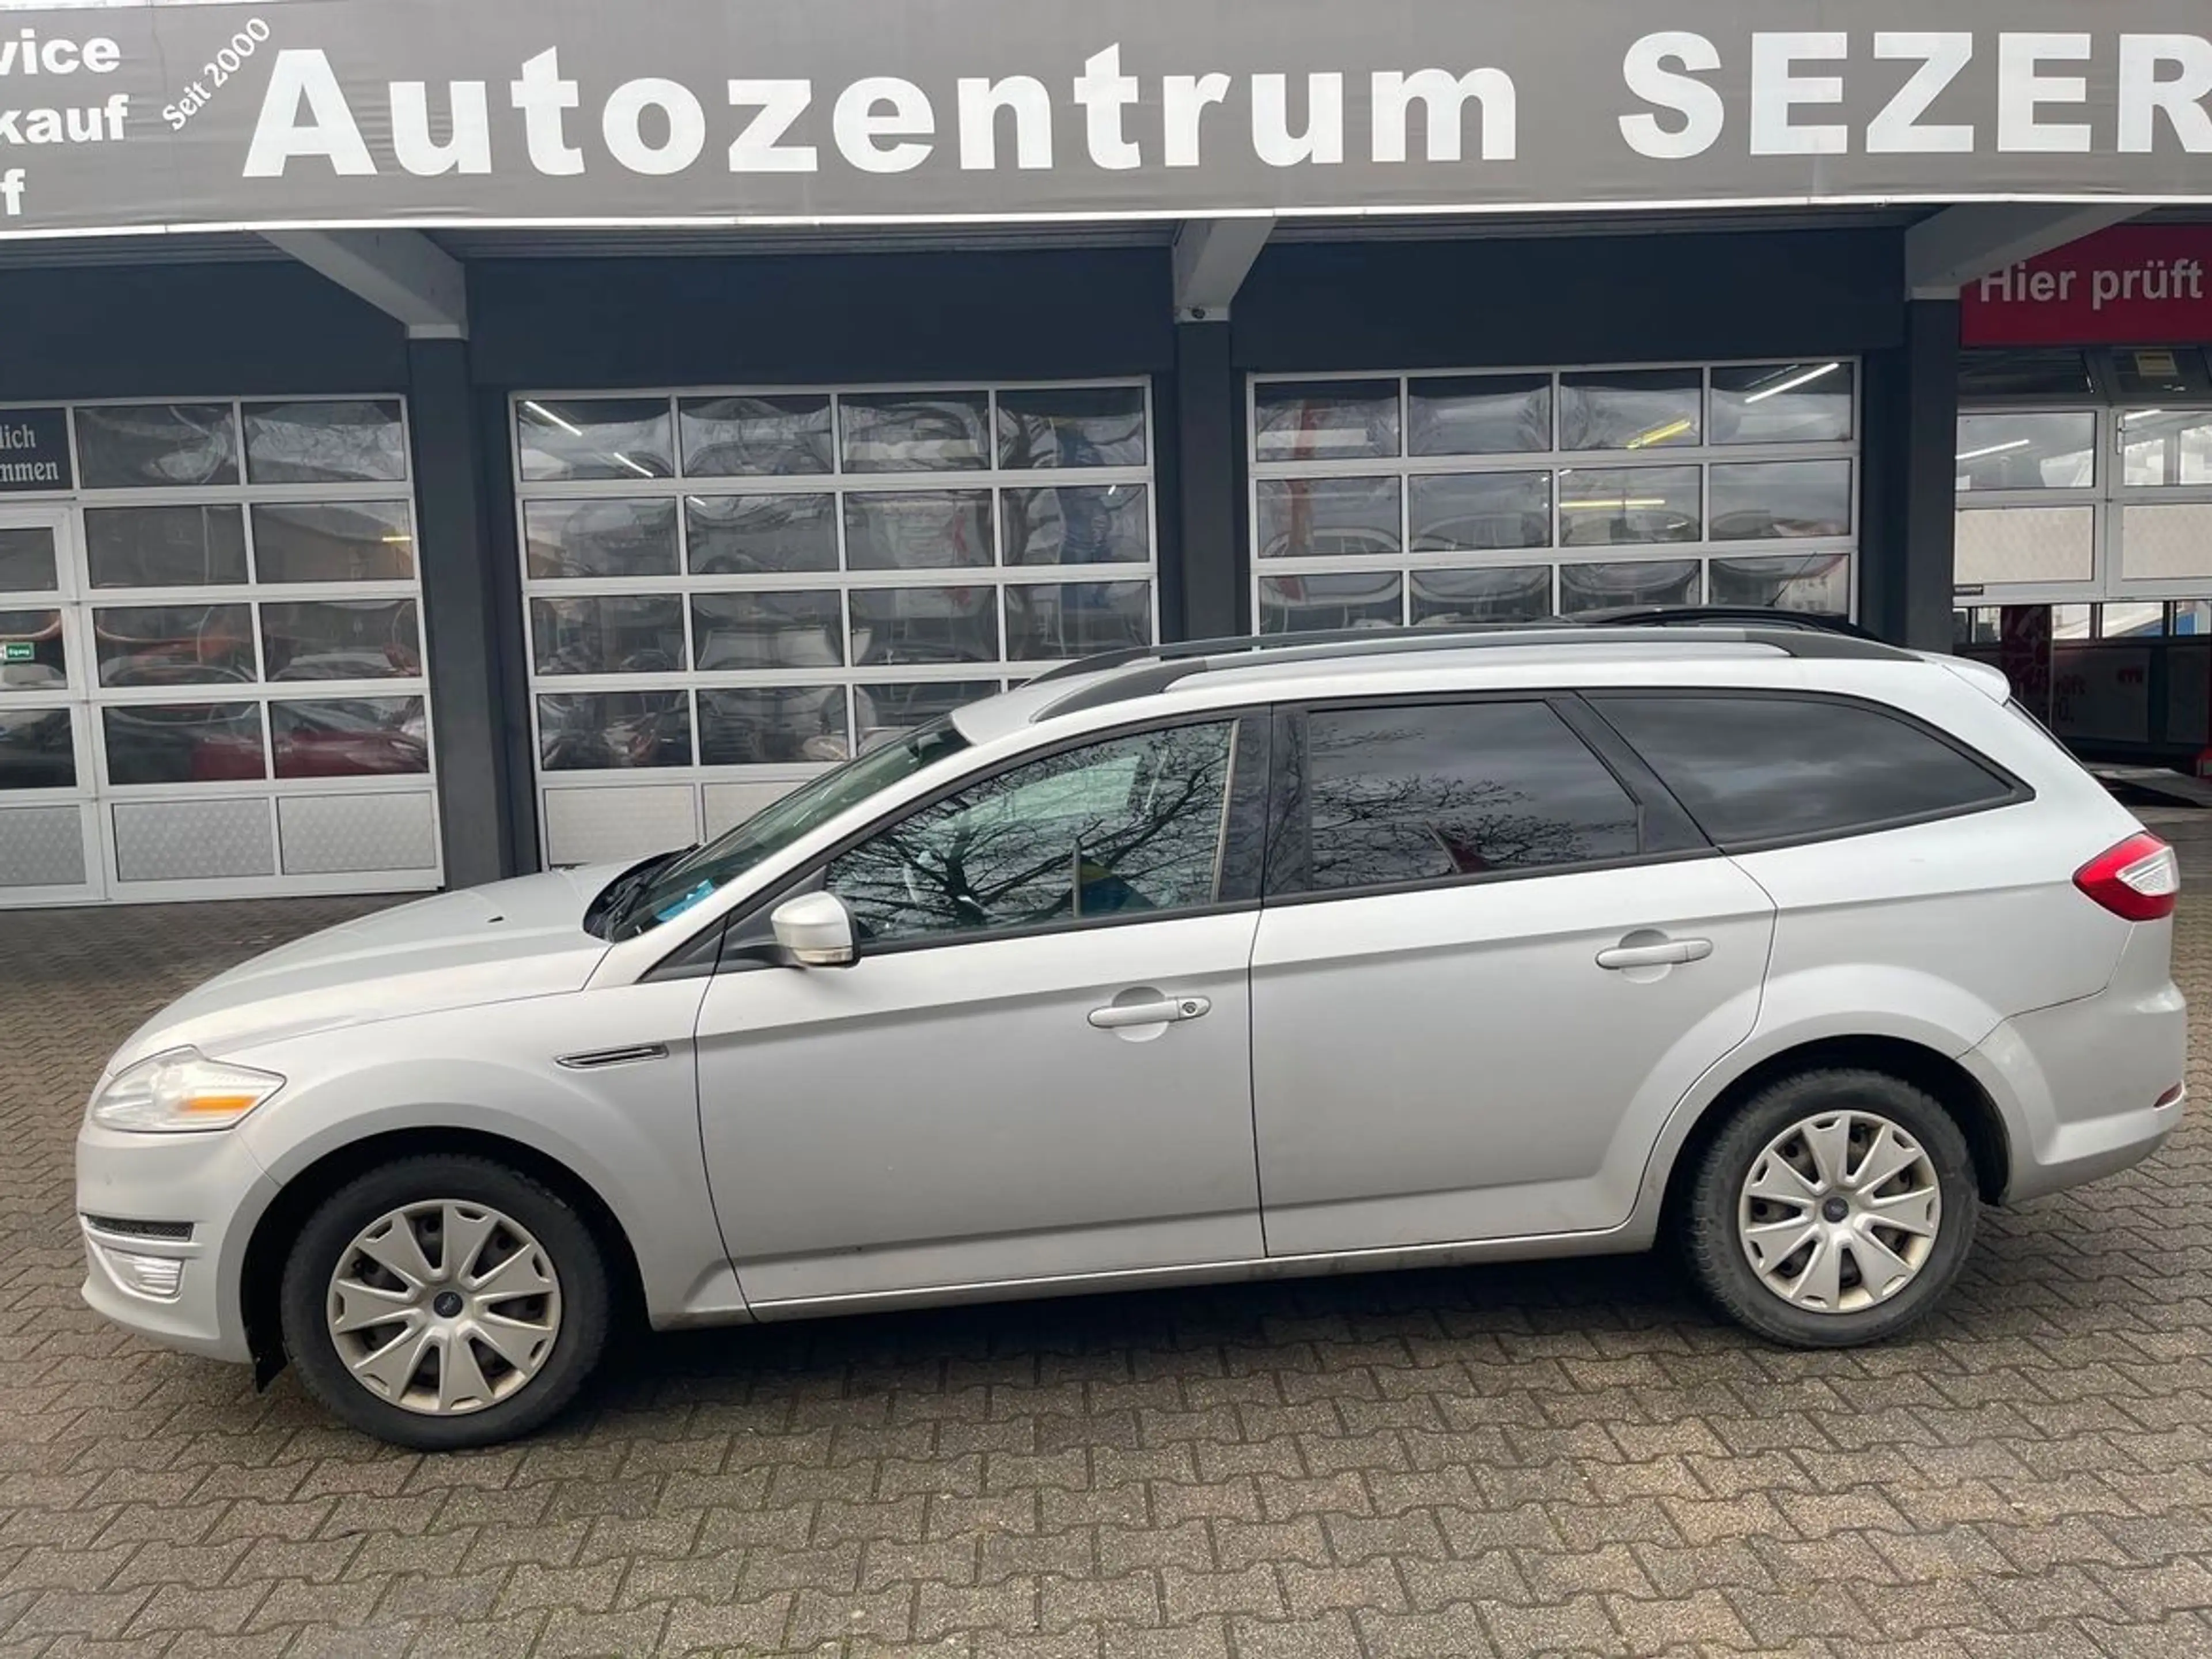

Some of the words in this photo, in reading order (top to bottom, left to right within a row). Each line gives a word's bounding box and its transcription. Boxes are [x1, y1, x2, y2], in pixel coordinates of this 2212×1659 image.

[162, 81, 212, 131] Seit
[204, 18, 270, 88] 2000
[242, 43, 1516, 177] Autozentrum
[1618, 31, 2212, 159] SEZER
[1980, 260, 2077, 302] Hier
[2092, 259, 2203, 310] prüft
